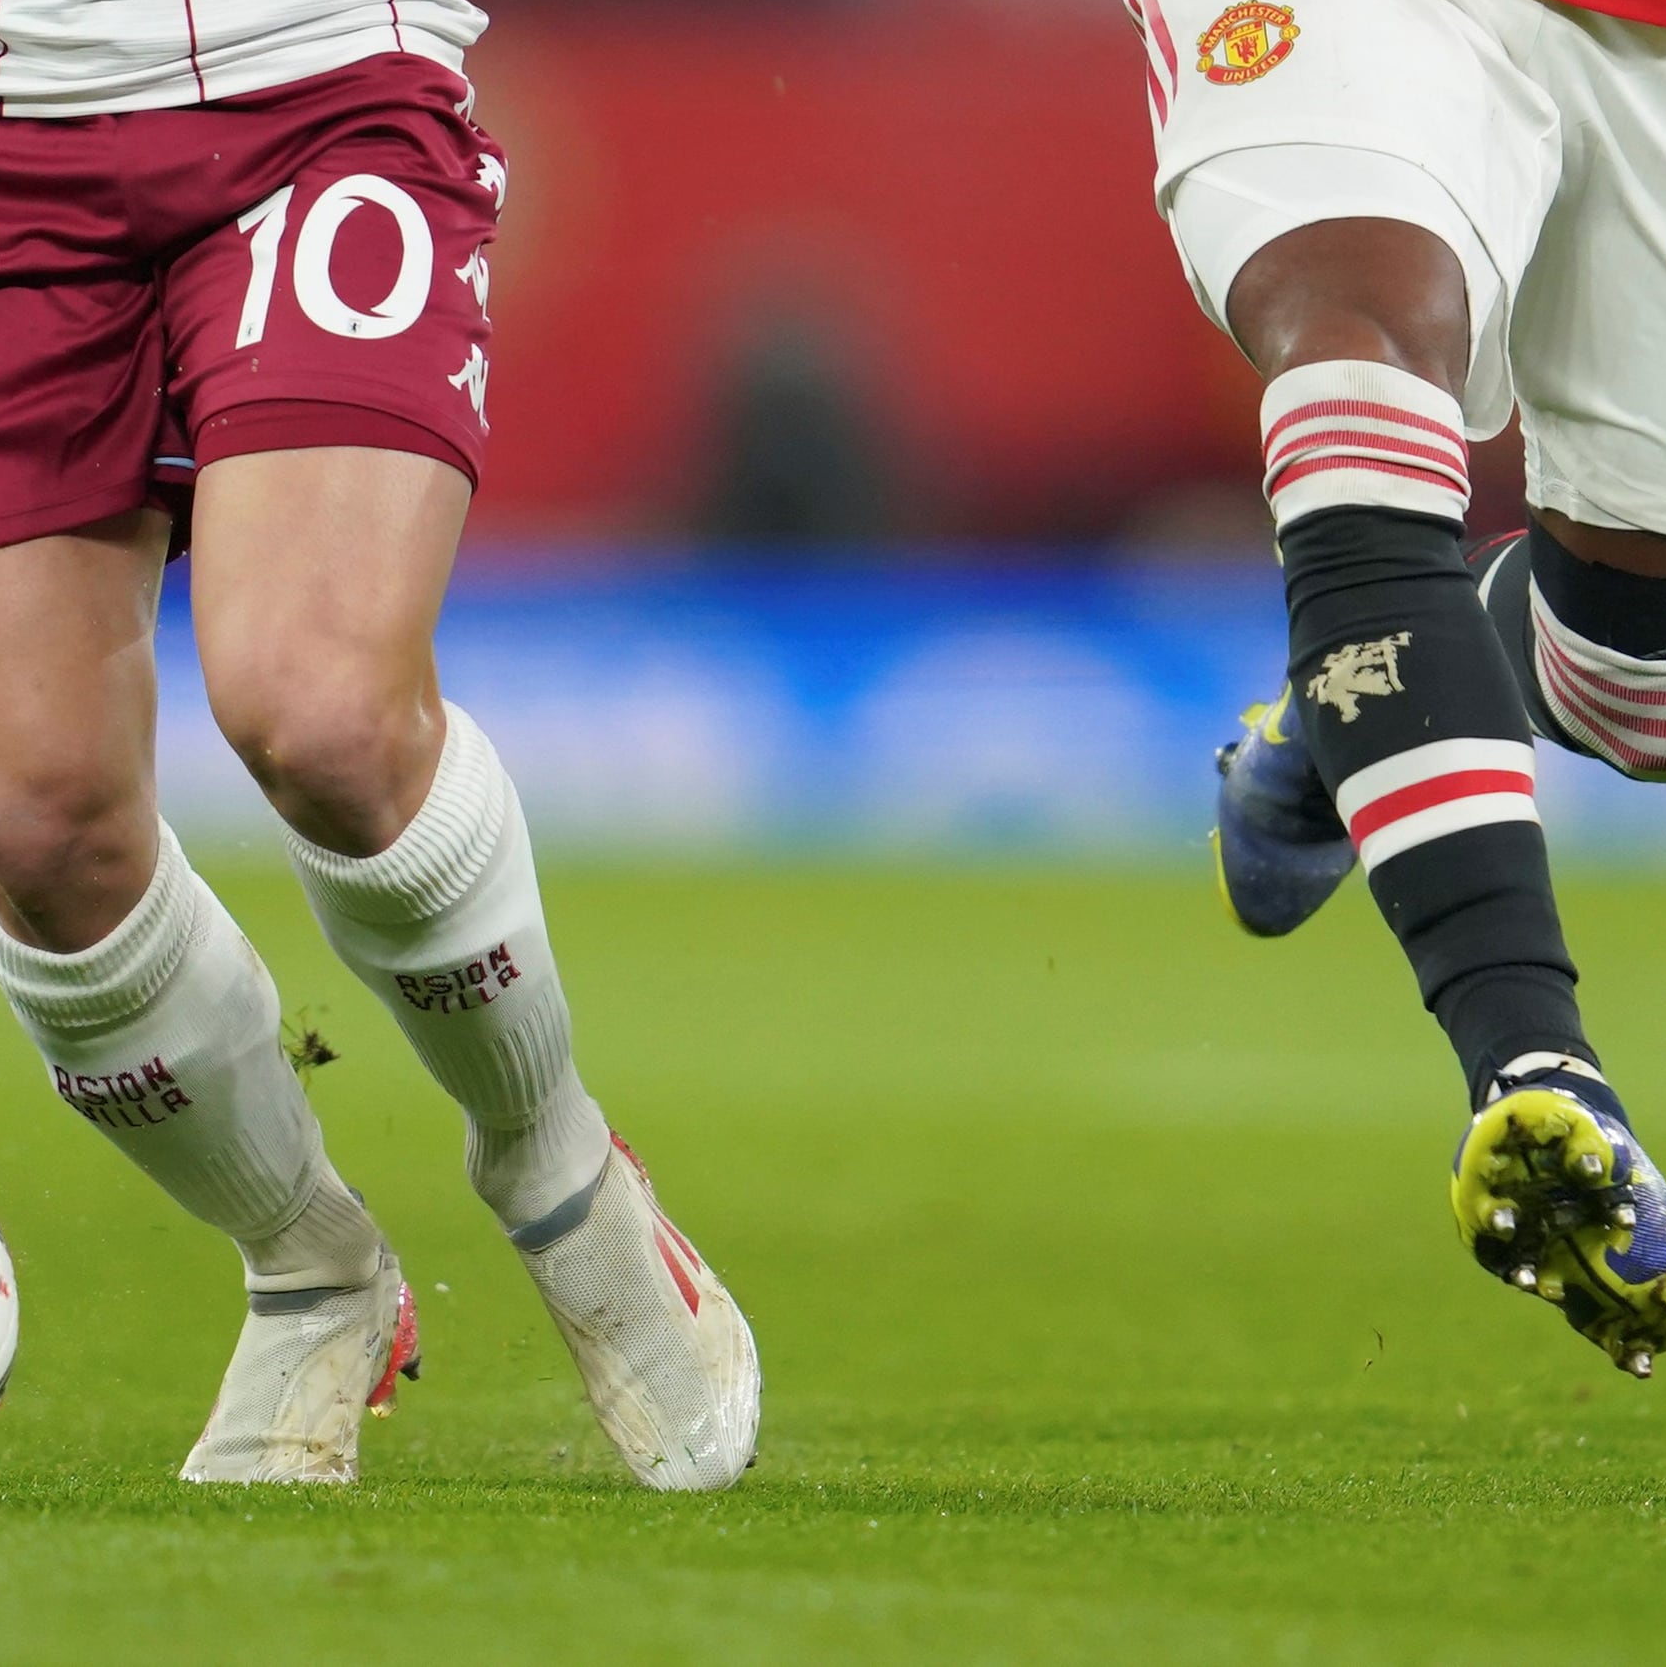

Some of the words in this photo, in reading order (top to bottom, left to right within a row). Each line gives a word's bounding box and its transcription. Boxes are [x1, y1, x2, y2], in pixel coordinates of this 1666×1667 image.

[1204, 5, 1286, 48] MANCHESTER
[1222, 53, 1280, 82] UNITED
[235, 173, 434, 350] 10
[395, 941, 511, 995] ASTON
[402, 964, 522, 1015] VILLA
[53, 1054, 176, 1106] ASTON
